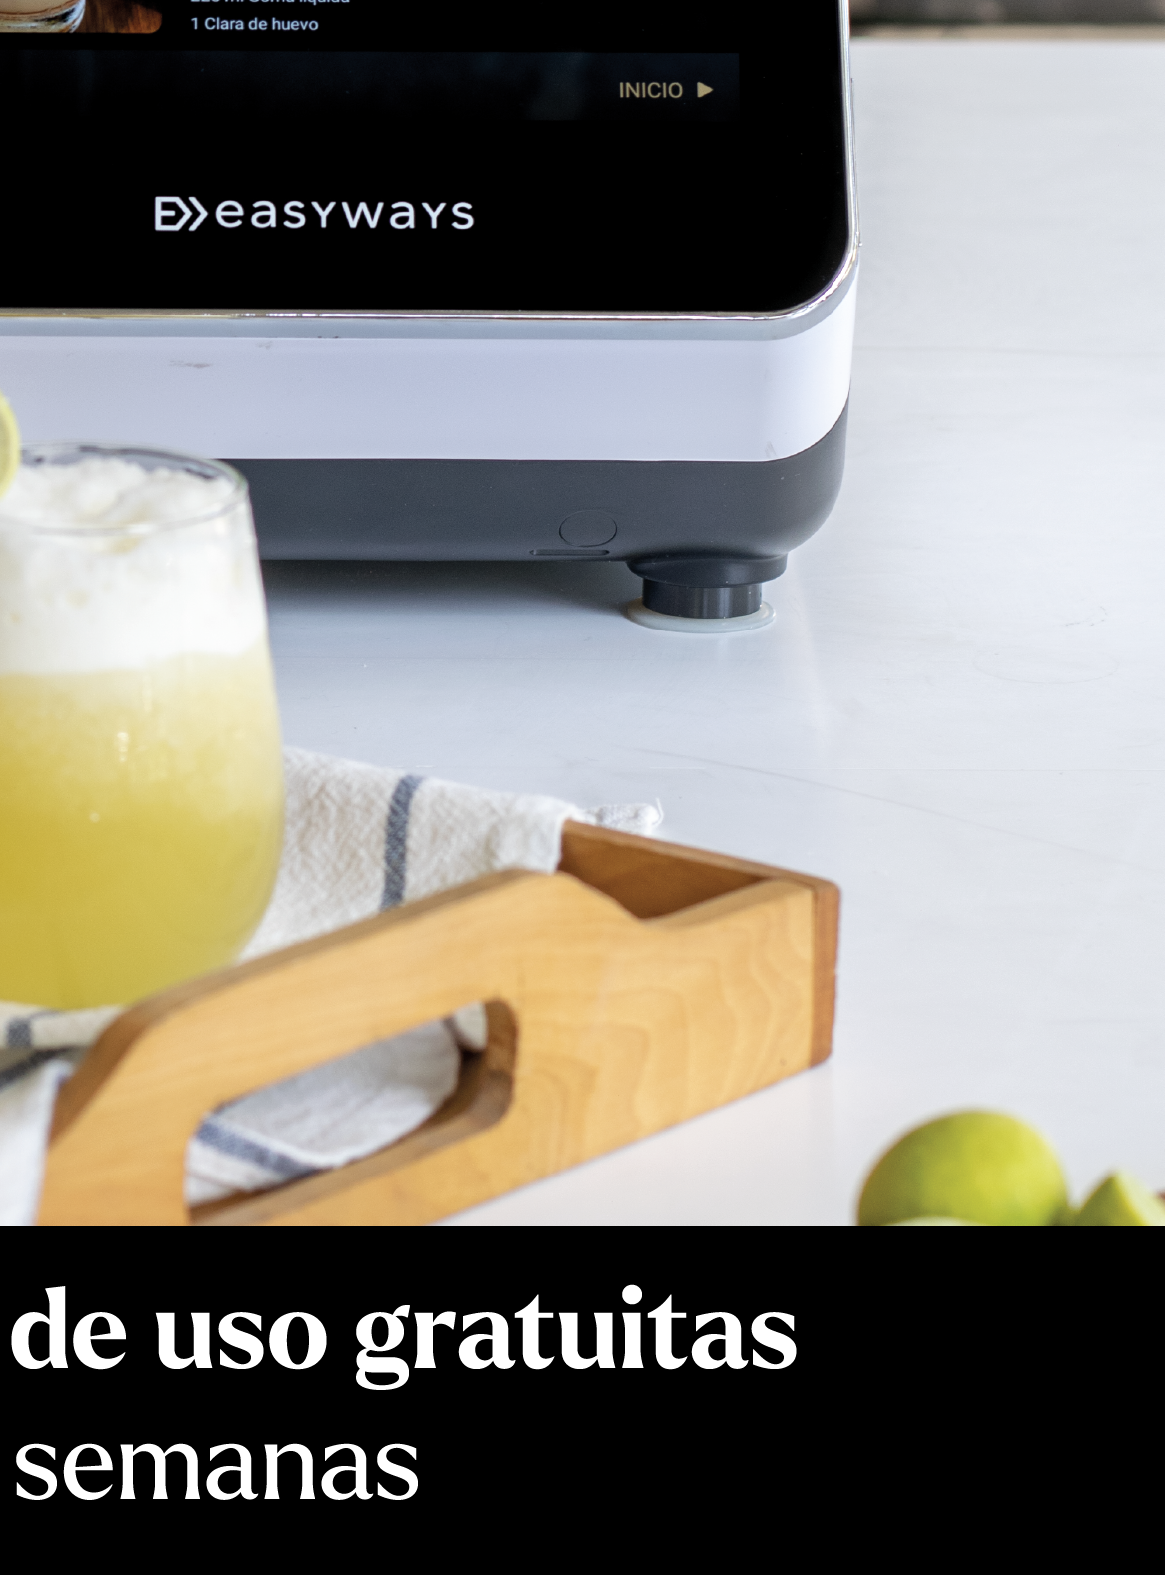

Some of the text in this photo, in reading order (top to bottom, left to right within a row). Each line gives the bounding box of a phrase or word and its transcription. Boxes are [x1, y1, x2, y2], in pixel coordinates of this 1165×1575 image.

[190, 16, 319, 31] 1 Clara de huevo
[619, 82, 683, 99] INICIO
